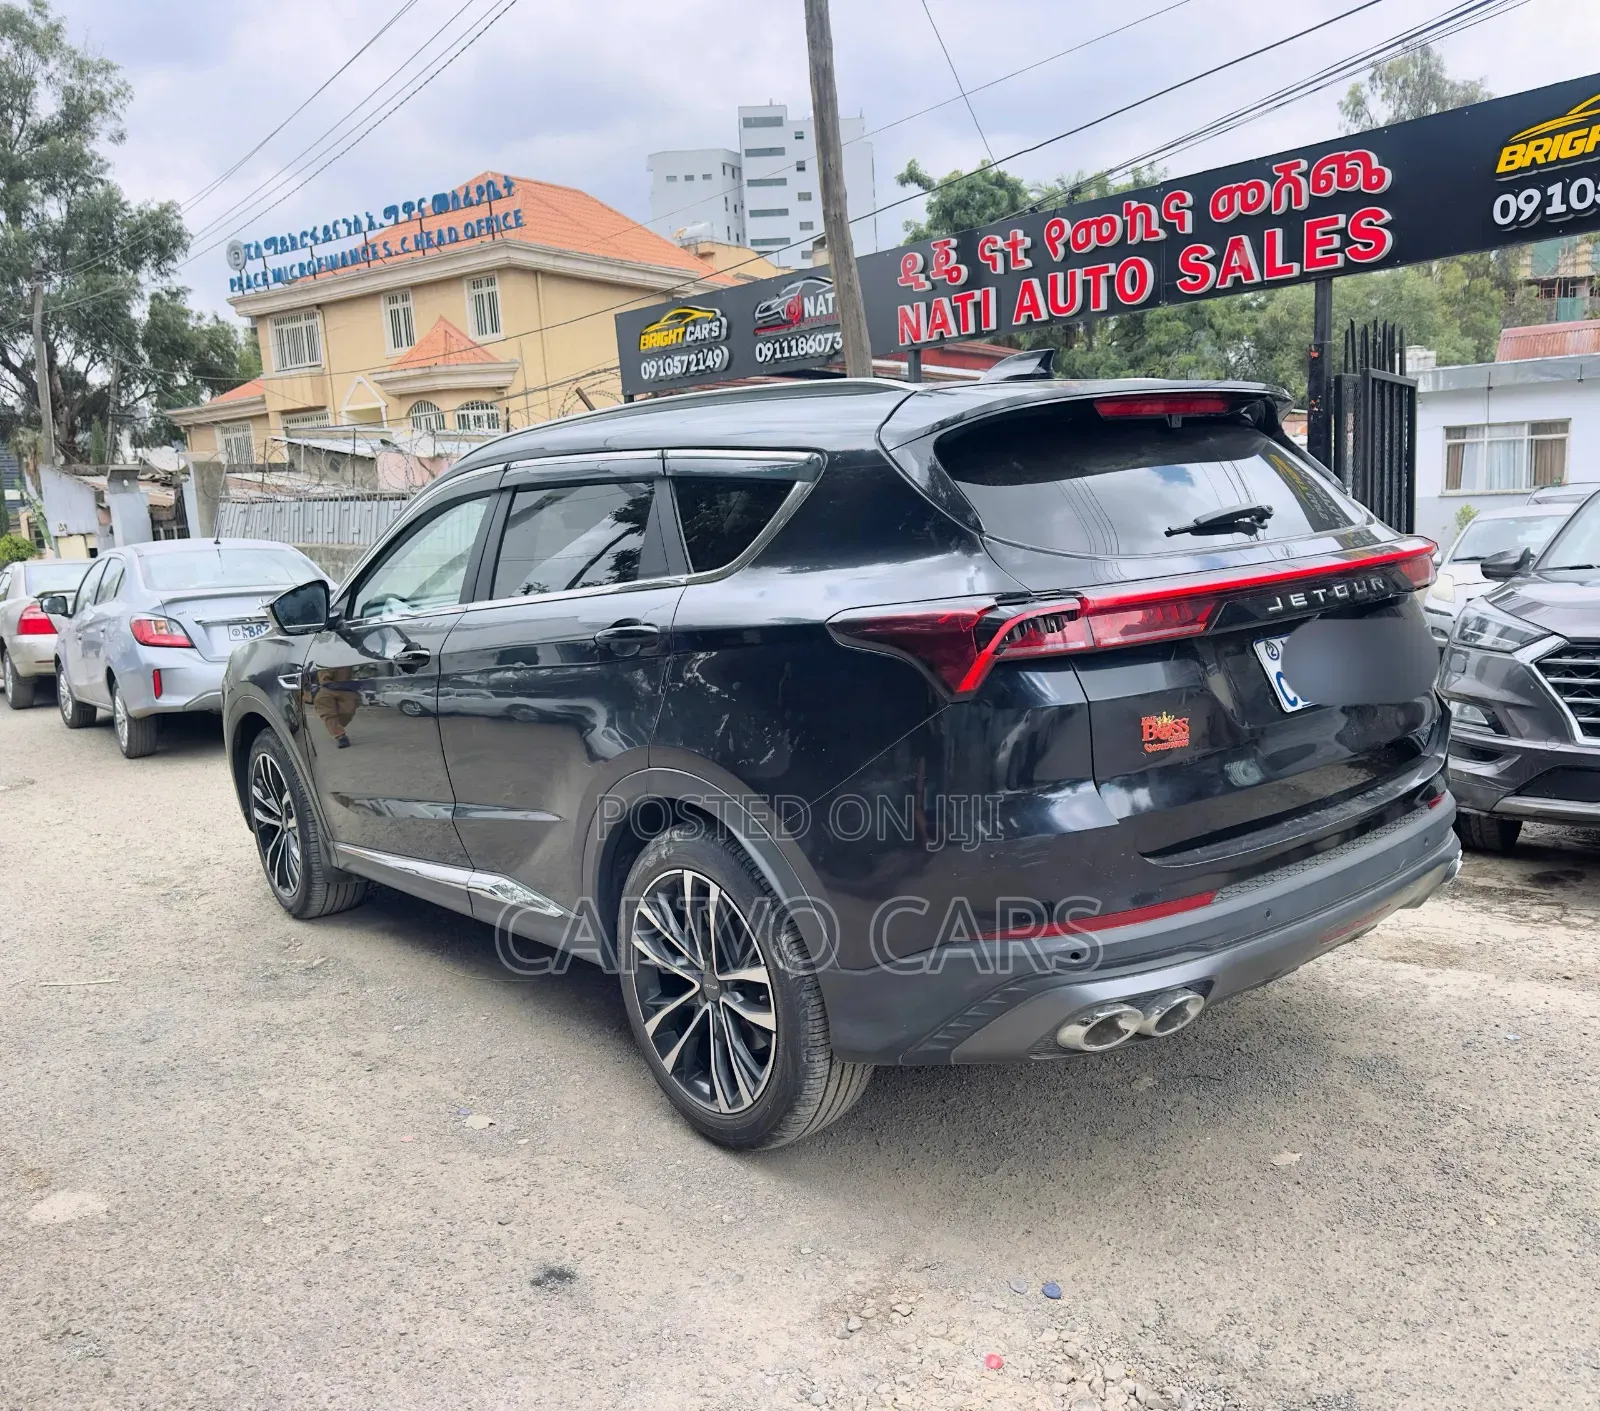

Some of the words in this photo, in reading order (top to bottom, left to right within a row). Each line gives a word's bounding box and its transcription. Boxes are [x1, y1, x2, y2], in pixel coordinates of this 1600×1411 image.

[978, 229, 1033, 274] ናቲ
[1044, 189, 1194, 263] የመኪና
[1210, 149, 1392, 223] መሸጫ
[1493, 177, 1600, 226] 0910
[229, 268, 270, 293] PEACE
[271, 243, 380, 284] MICROFINANCE
[413, 226, 459, 251] HEAD
[464, 208, 525, 240] OFFICE
[898, 287, 997, 346] NATI
[1012, 256, 1155, 326] AUTO
[1177, 207, 1393, 294] SALES
[640, 326, 686, 351] BRIGHT
[685, 321, 722, 341] CAR'S
[755, 331, 843, 363] 0911186073
[640, 348, 724, 380] 0910572149
[1267, 577, 1386, 612] JETOUR
